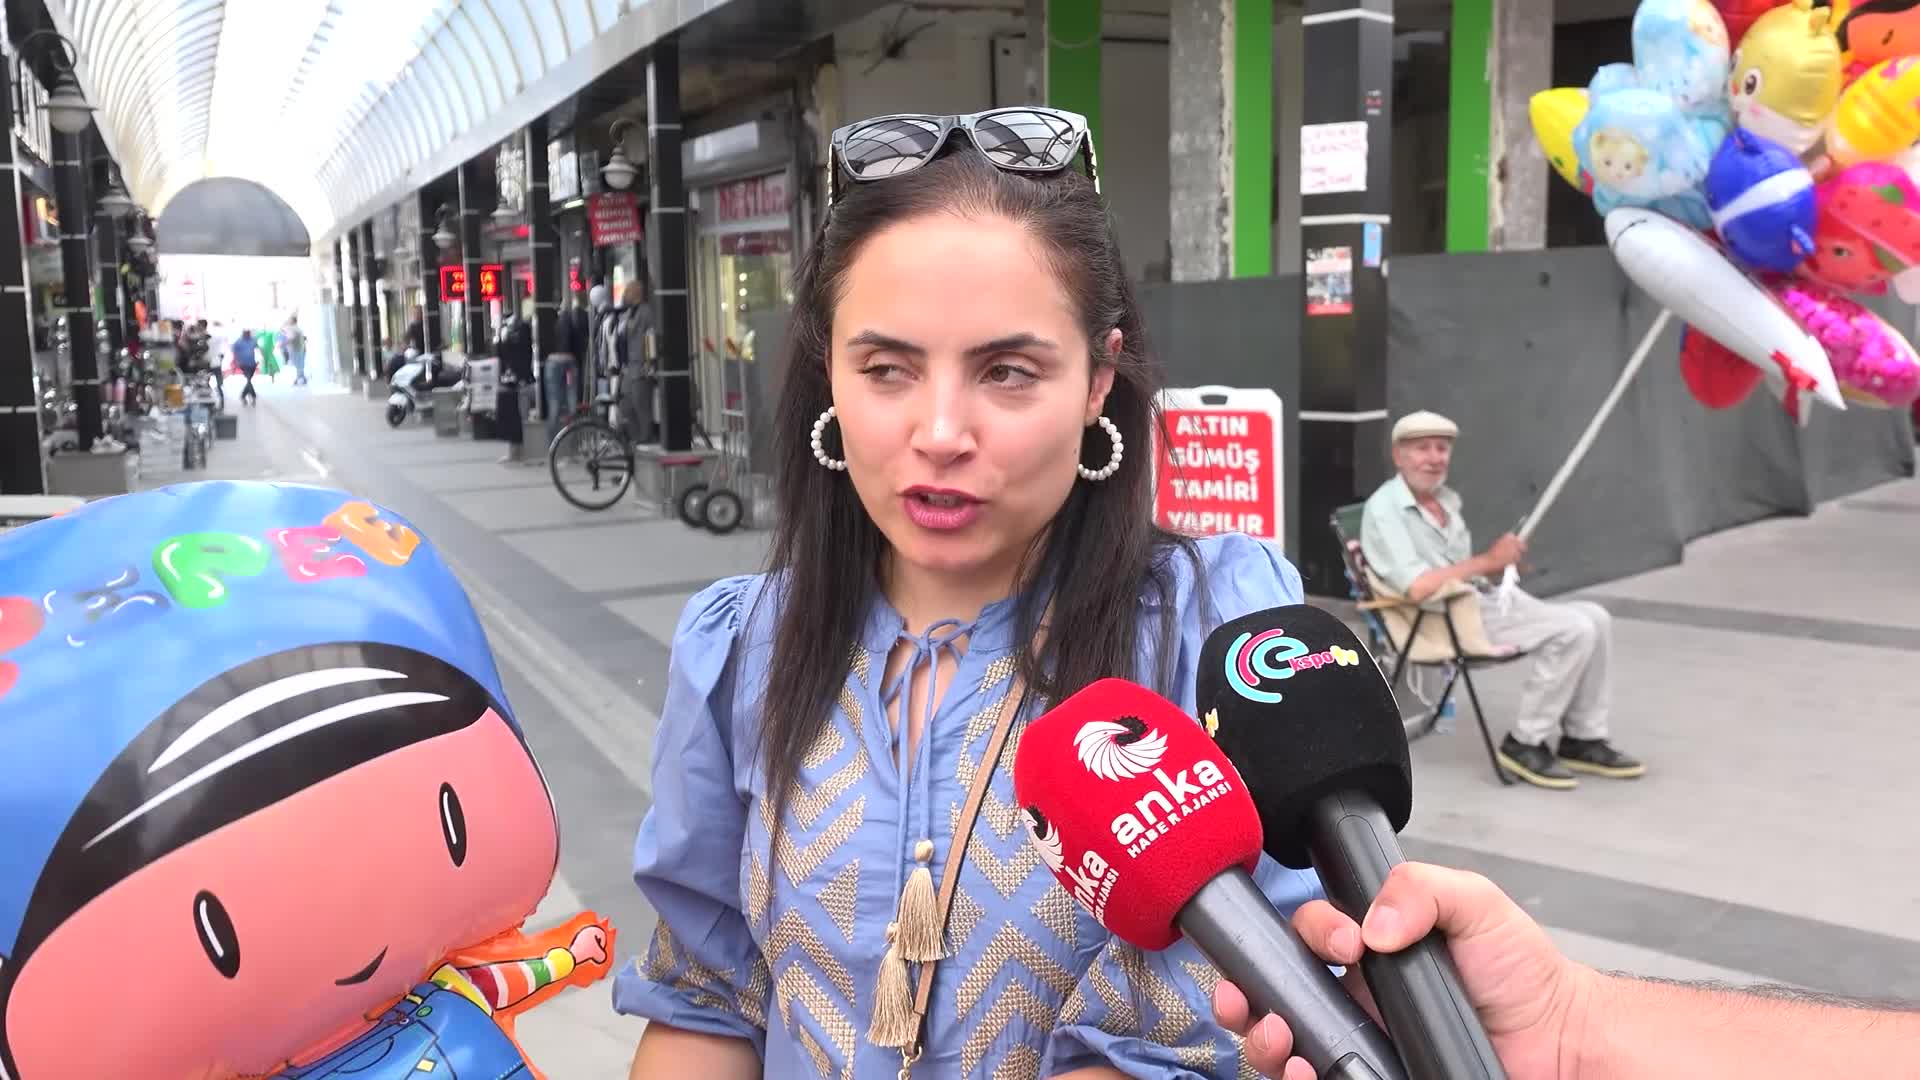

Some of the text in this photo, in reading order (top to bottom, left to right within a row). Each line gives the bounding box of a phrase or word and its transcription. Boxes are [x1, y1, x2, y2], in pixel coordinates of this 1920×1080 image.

[1176, 415, 1248, 436] ALTIN
[1168, 441, 1260, 474] GÜMÜŞ
[1170, 475, 1259, 502] TAMİRİ
[1167, 511, 1264, 535] YAPILIR
[1111, 760, 1225, 845] anka
[1126, 781, 1232, 858] HABER AJANSI
[1065, 850, 1109, 919] nka
